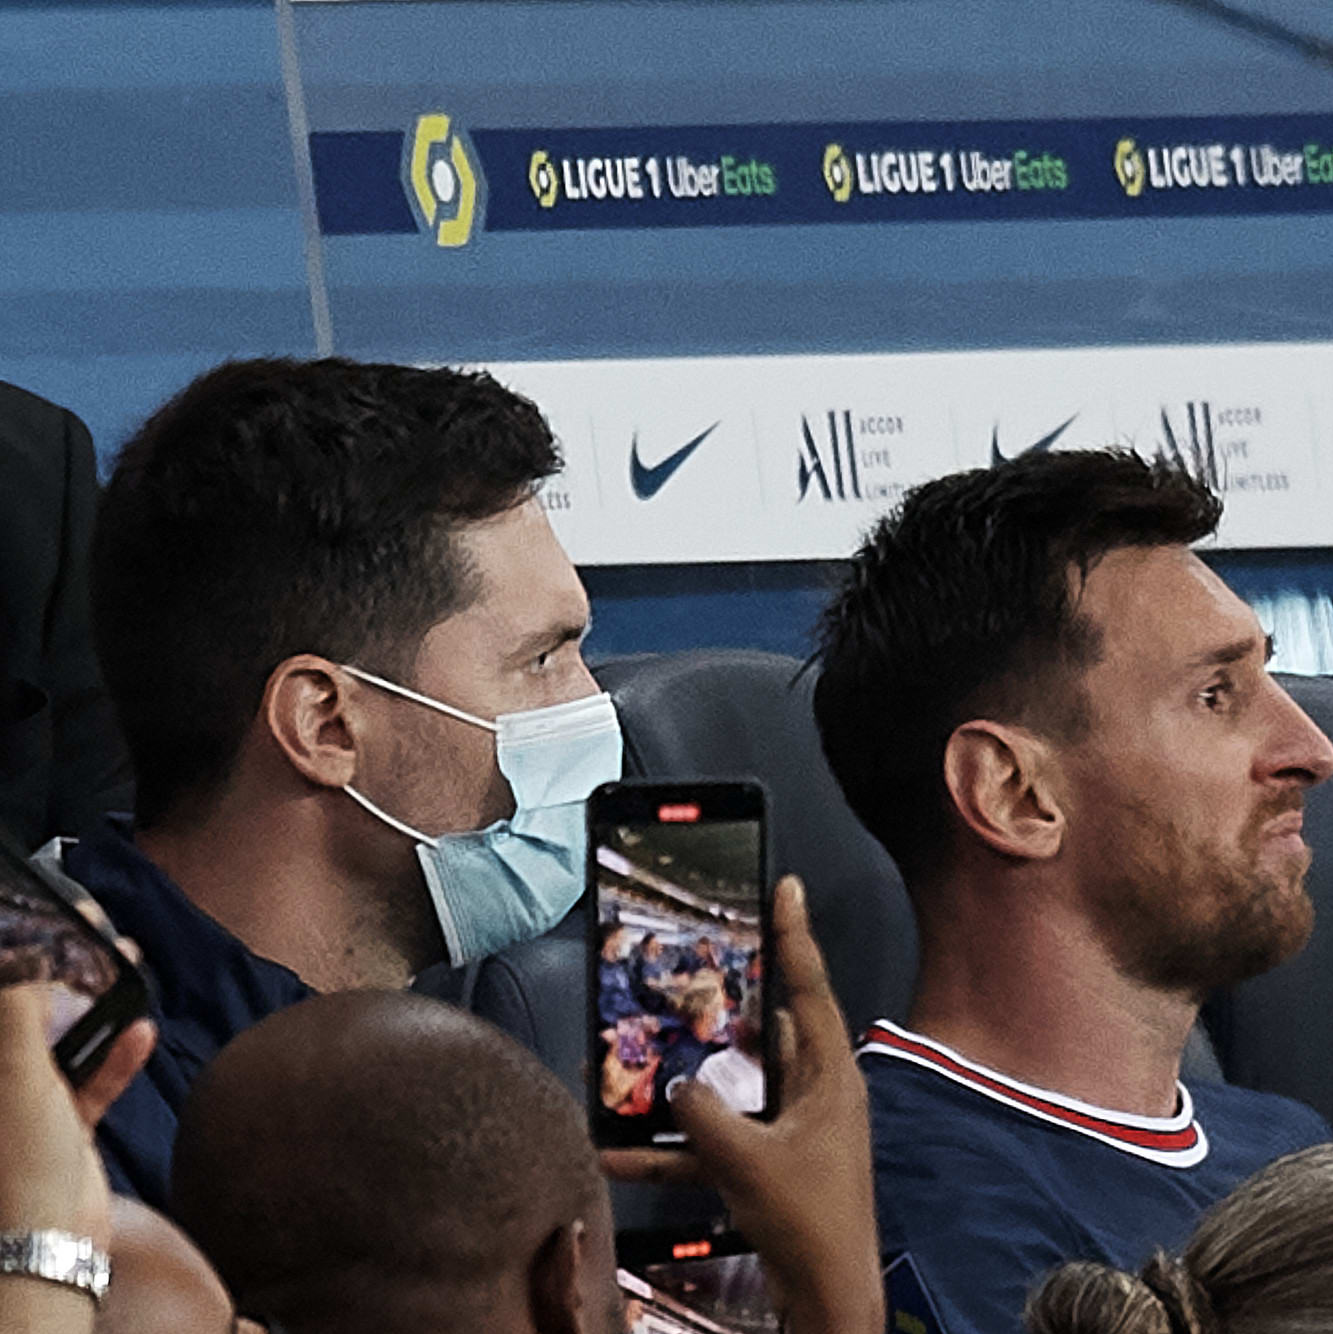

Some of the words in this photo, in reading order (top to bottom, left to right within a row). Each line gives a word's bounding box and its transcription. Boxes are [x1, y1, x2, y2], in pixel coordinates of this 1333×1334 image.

[562, 156, 645, 199] LIGUE
[646, 157, 661, 198] 1
[856, 151, 938, 194] LIGUE
[939, 152, 955, 192] 1
[1148, 145, 1229, 188] LIGUE
[1230, 145, 1246, 187] 1
